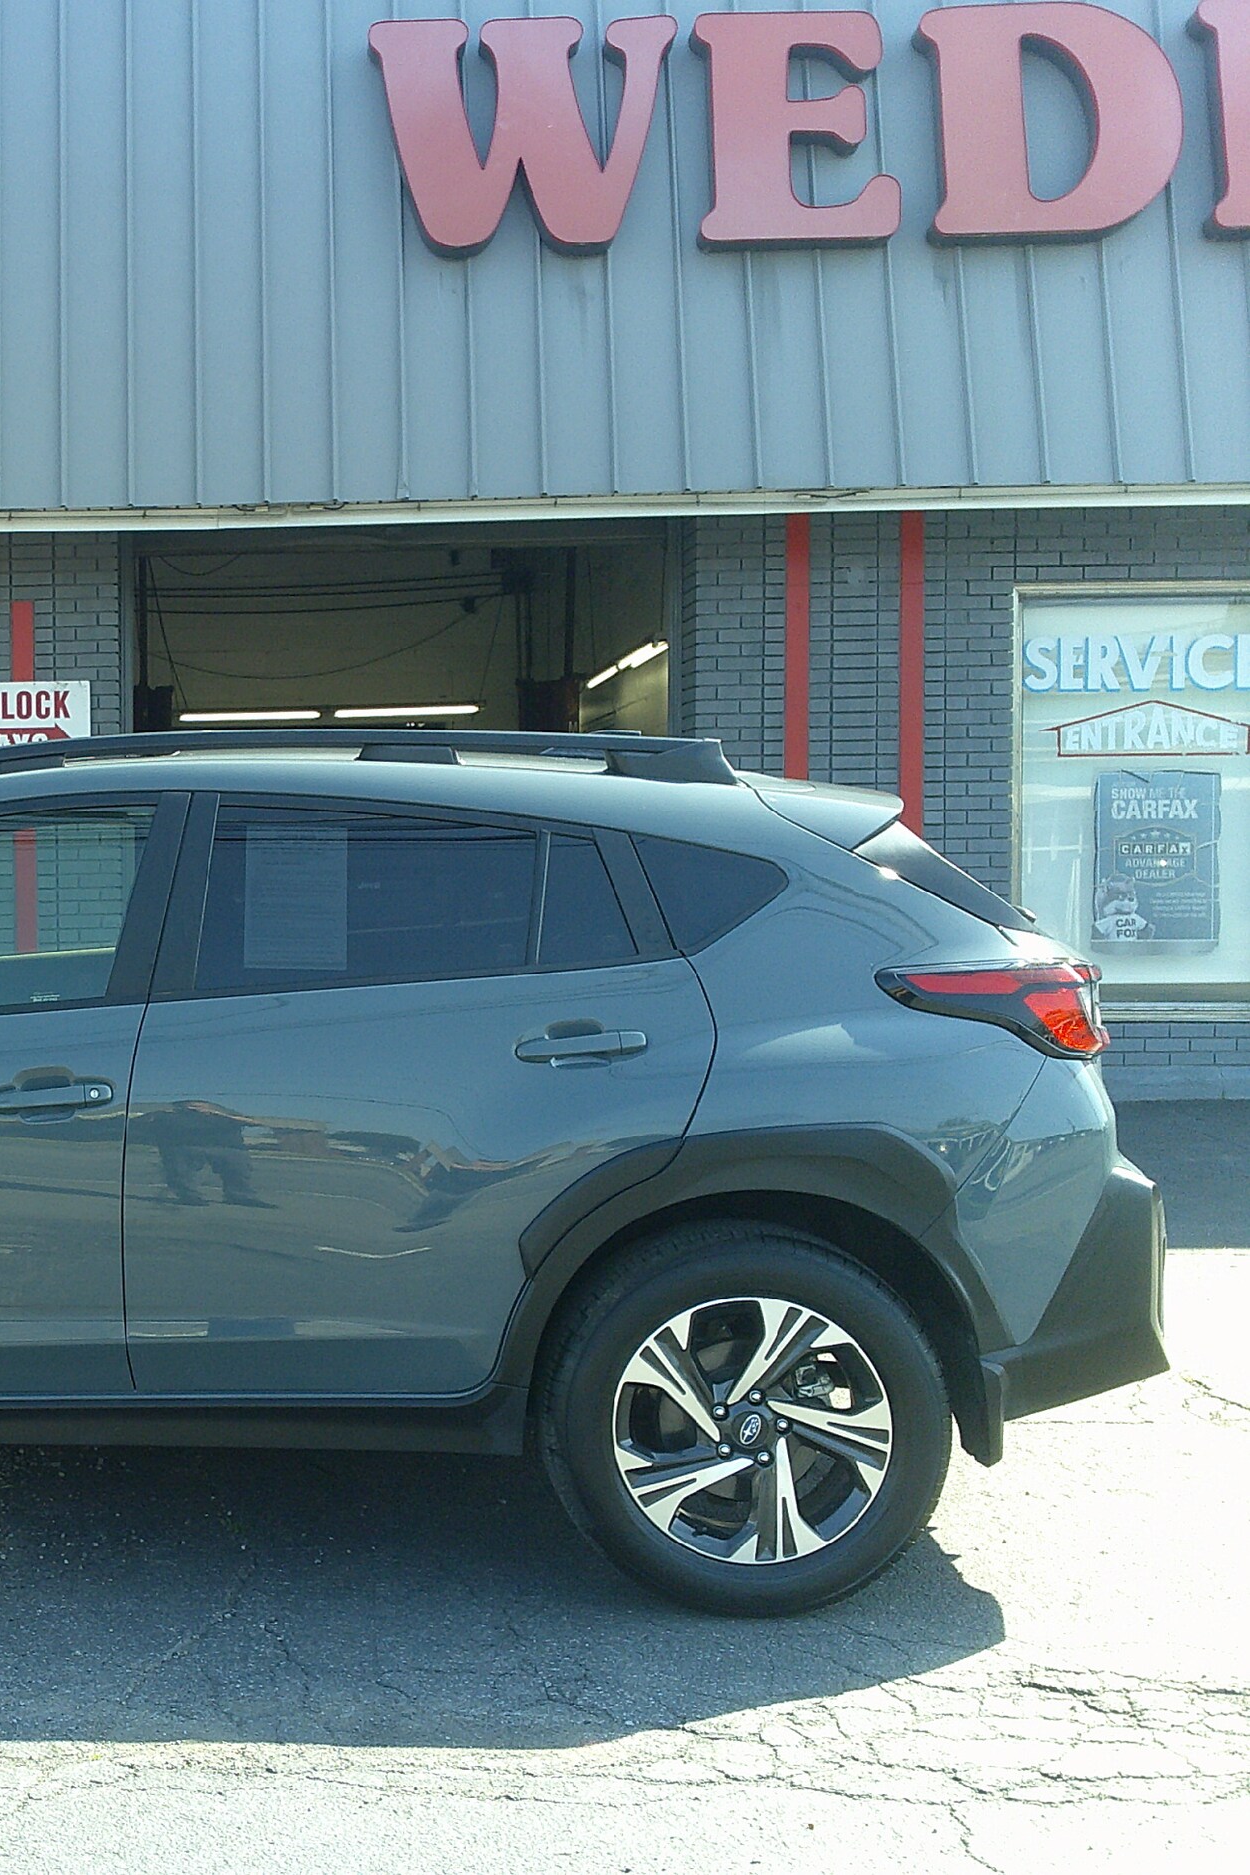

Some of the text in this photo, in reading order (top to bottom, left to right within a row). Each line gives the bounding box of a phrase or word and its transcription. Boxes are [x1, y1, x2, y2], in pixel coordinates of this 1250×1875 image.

[1065, 706, 1239, 751] ENTRANCE
[1111, 787, 1146, 799] SHOW
[1111, 799, 1198, 819] CARFAX
[1120, 843, 1190, 855] CARFAX
[1125, 858, 1186, 868] ADVANAGE
[1135, 869, 1176, 879] DEALER
[1116, 918, 1136, 928] CAR
[1116, 929, 1136, 938] FOX
